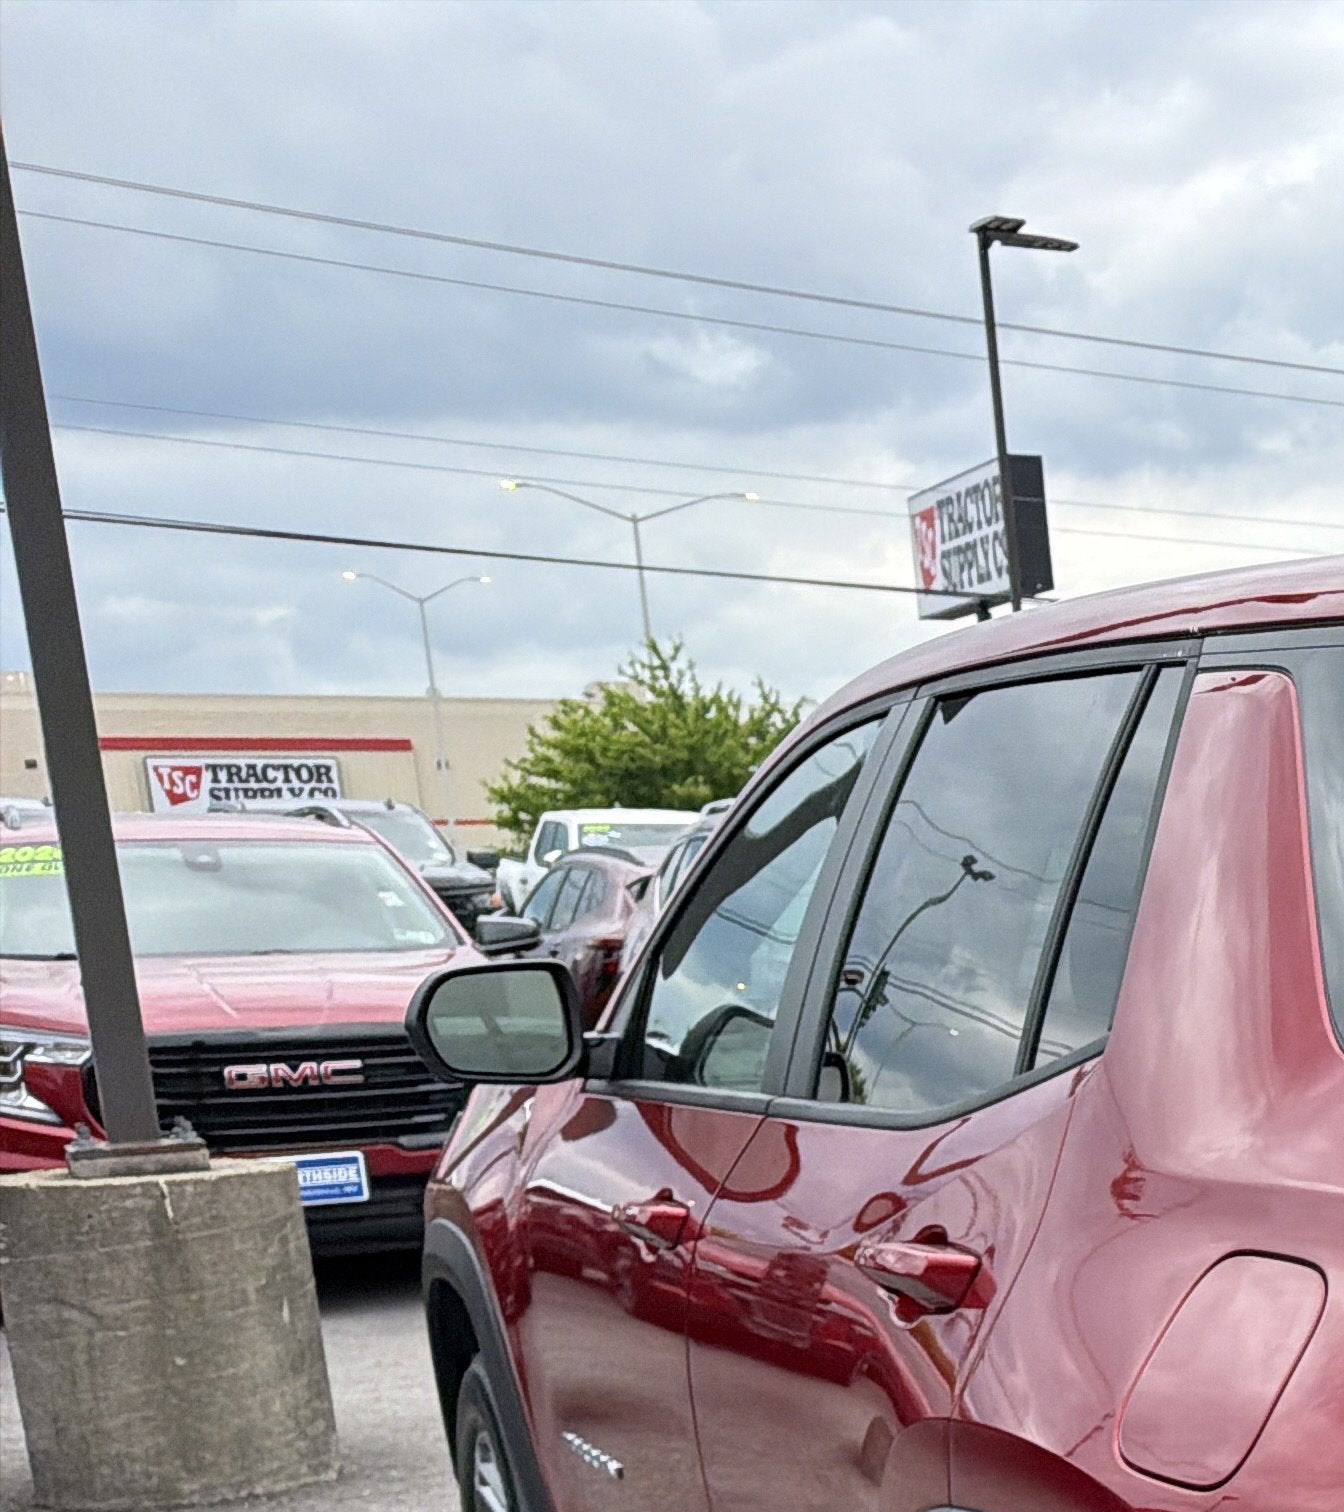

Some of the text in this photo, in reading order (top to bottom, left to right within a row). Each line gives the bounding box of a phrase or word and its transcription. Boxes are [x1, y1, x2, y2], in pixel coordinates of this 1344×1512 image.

[158, 767, 198, 799] TSC
[205, 763, 334, 785] TRACTOR
[224, 1059, 365, 1090] GMC
